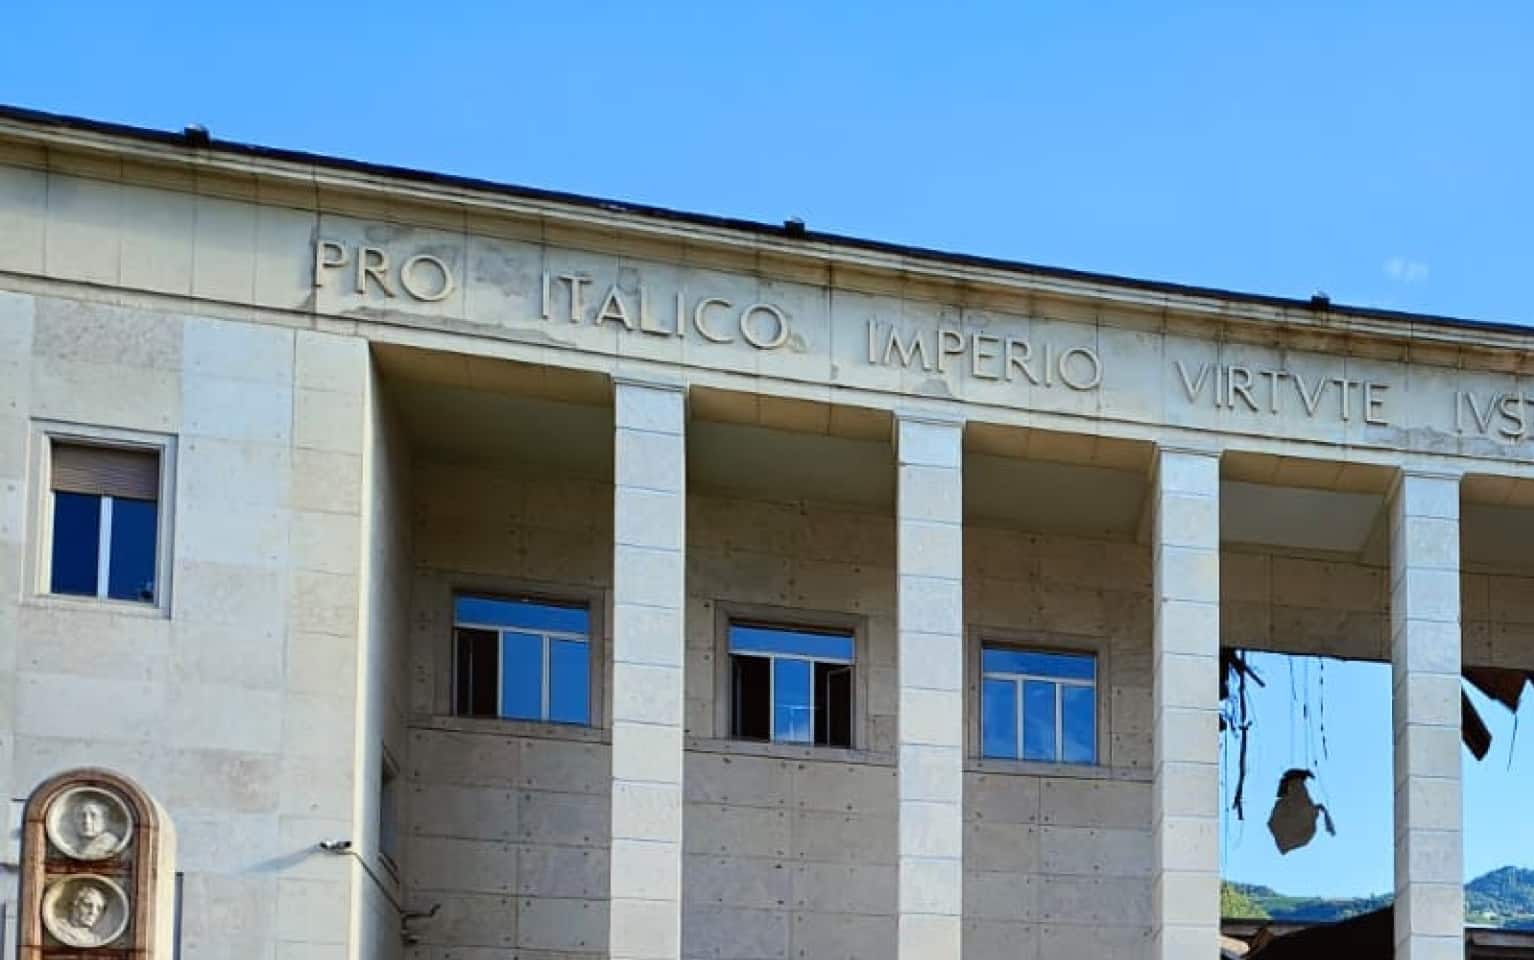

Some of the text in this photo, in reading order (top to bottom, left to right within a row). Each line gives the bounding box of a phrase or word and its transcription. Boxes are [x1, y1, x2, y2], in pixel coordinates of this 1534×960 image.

[314, 240, 456, 302] PRO
[541, 268, 792, 351] ITALICO
[866, 320, 1102, 392] IMPERIO
[1177, 359, 1391, 425] VIRTVTE
